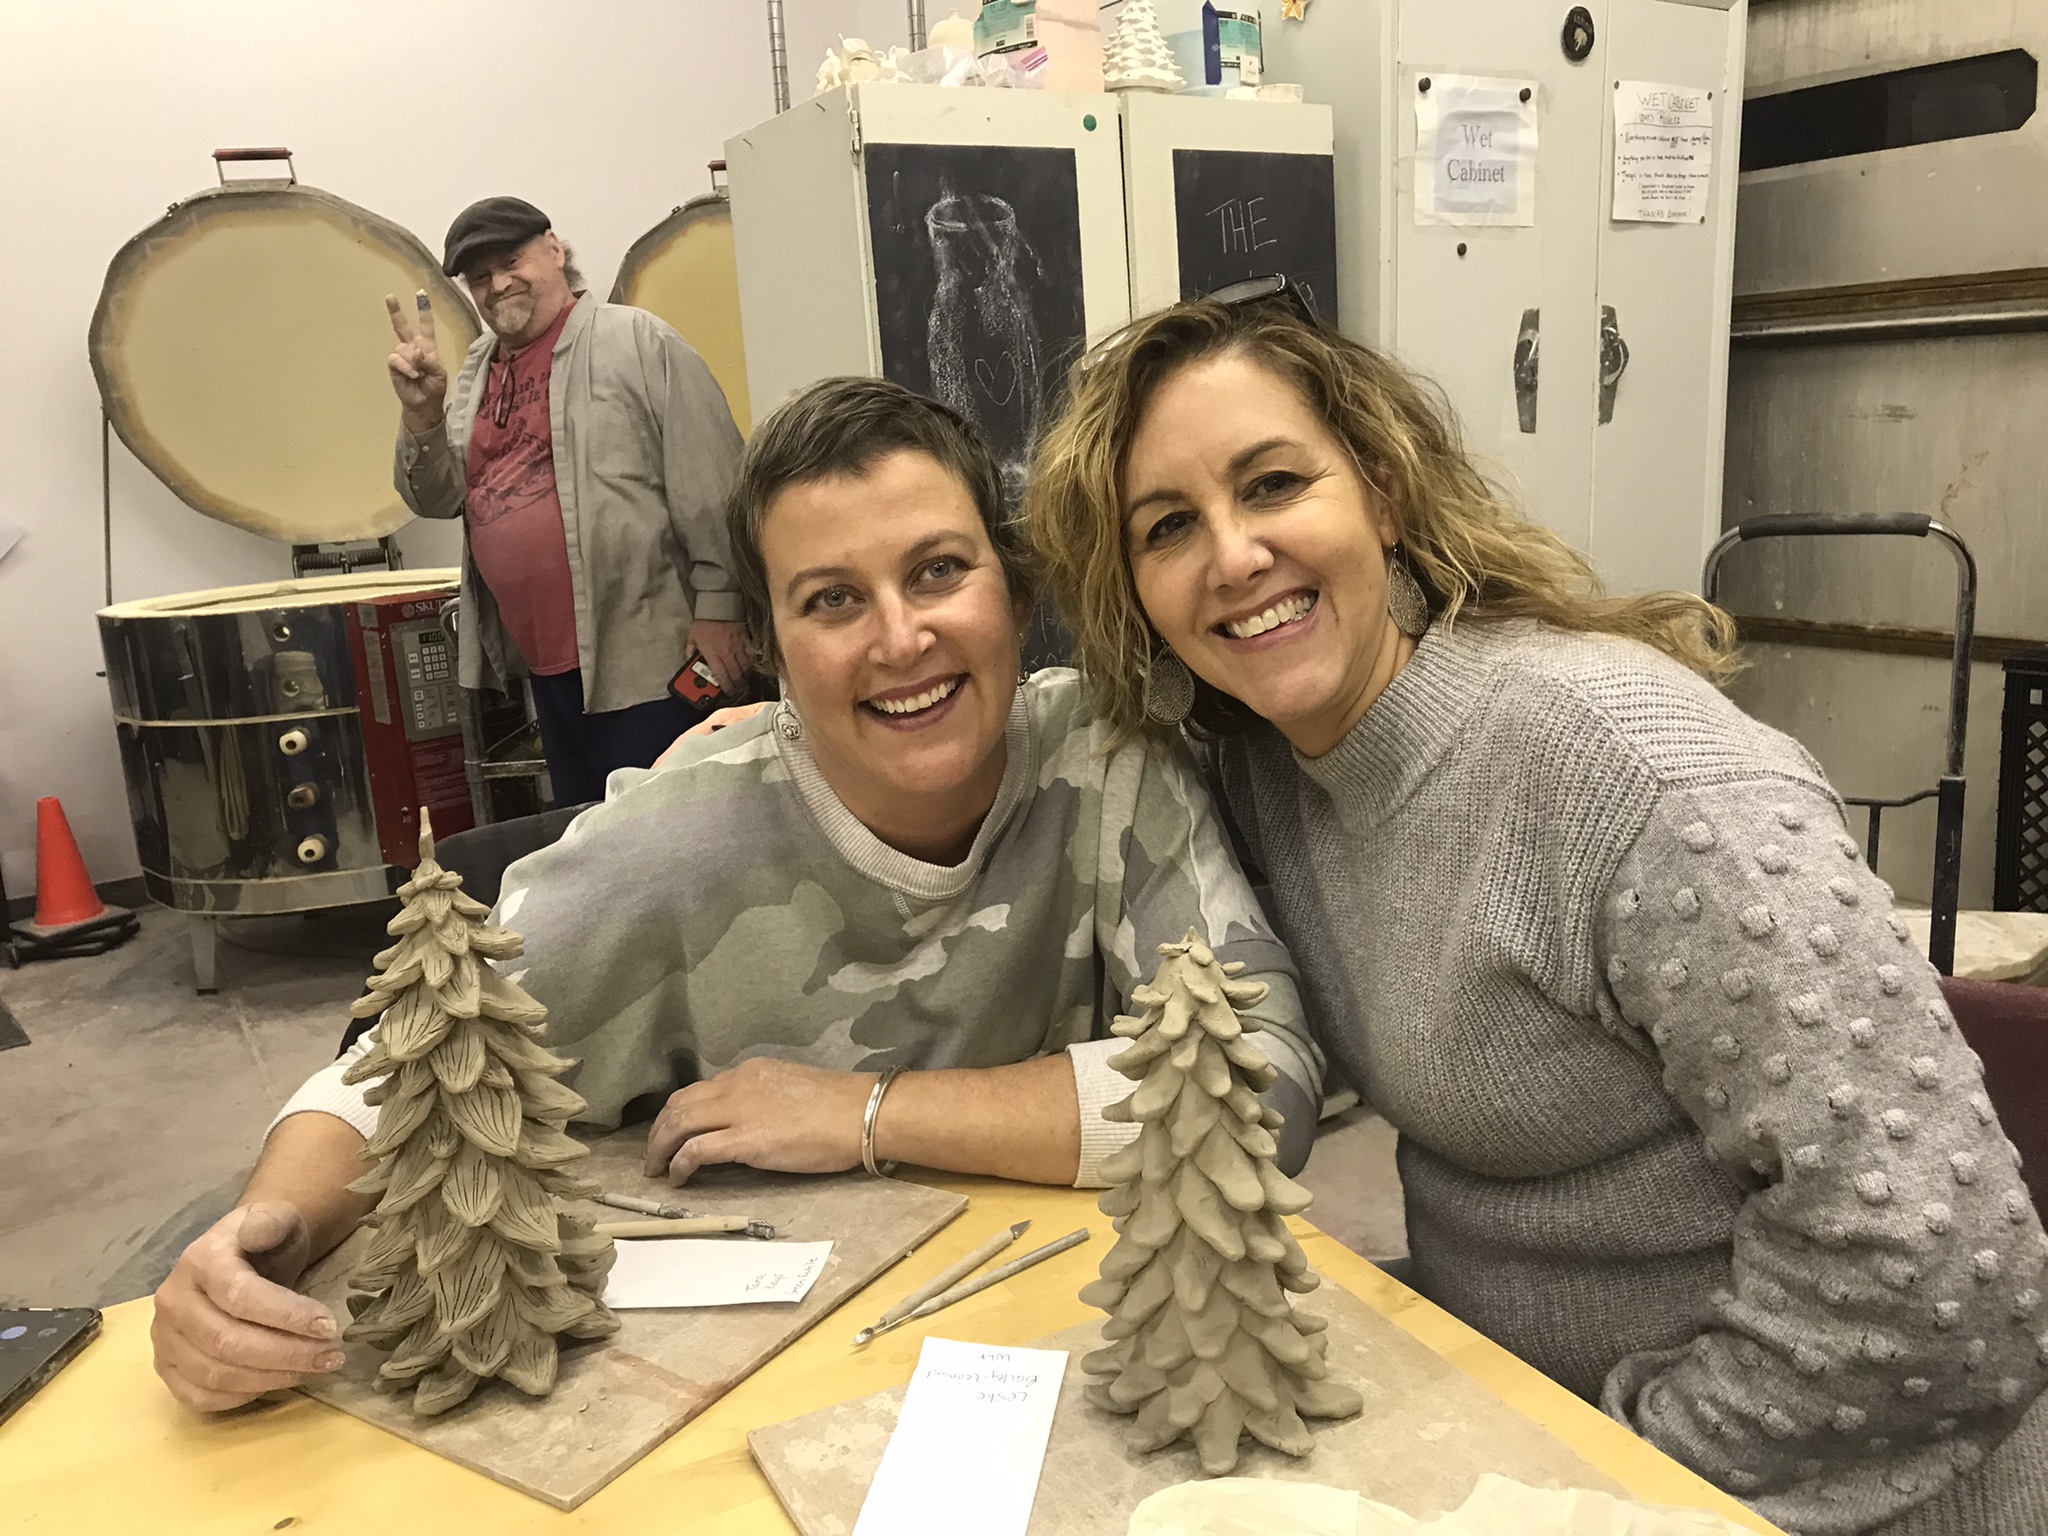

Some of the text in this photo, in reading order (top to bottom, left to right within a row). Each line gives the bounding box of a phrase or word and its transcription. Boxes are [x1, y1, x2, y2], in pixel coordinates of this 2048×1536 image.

[1636, 92, 1667, 106] WET
[1461, 124, 1493, 148] Wet
[1447, 159, 1505, 182] Cabinet
[1205, 197, 1277, 253] THE
[746, 1273, 768, 1292] Tara
